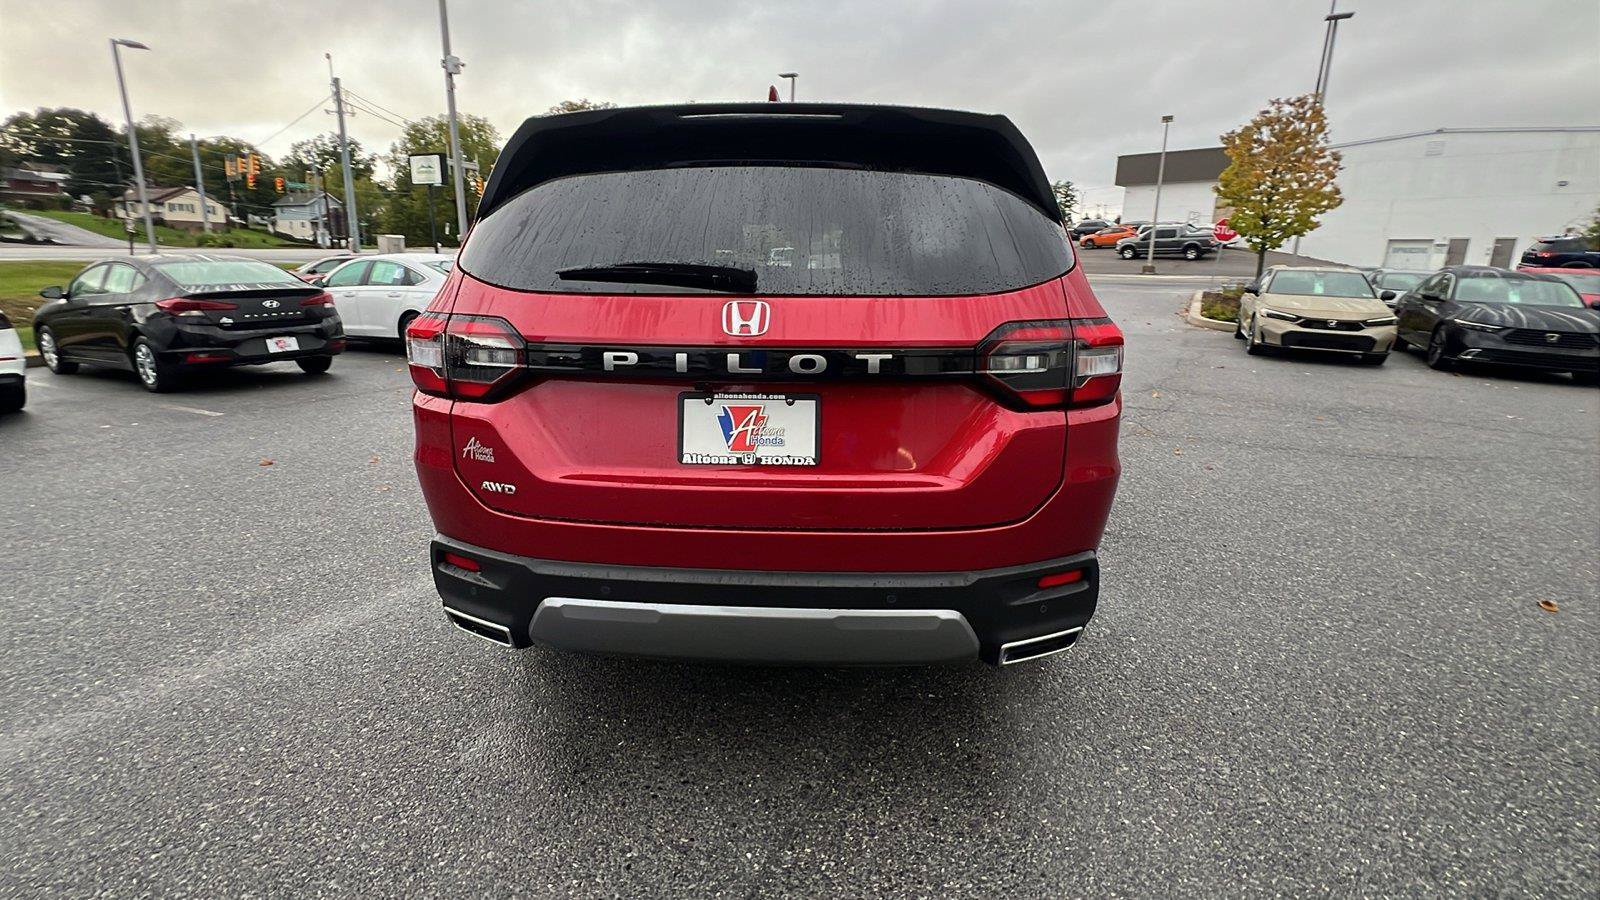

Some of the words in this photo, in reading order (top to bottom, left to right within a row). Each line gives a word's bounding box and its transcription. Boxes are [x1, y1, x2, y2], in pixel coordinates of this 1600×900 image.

[603, 352, 893, 373] PILOT
[729, 409, 785, 447] Altoona
[750, 436, 784, 446] Honda
[682, 453, 737, 464] Altoona
[760, 455, 816, 466] HONDA
[481, 481, 516, 495] AWD
